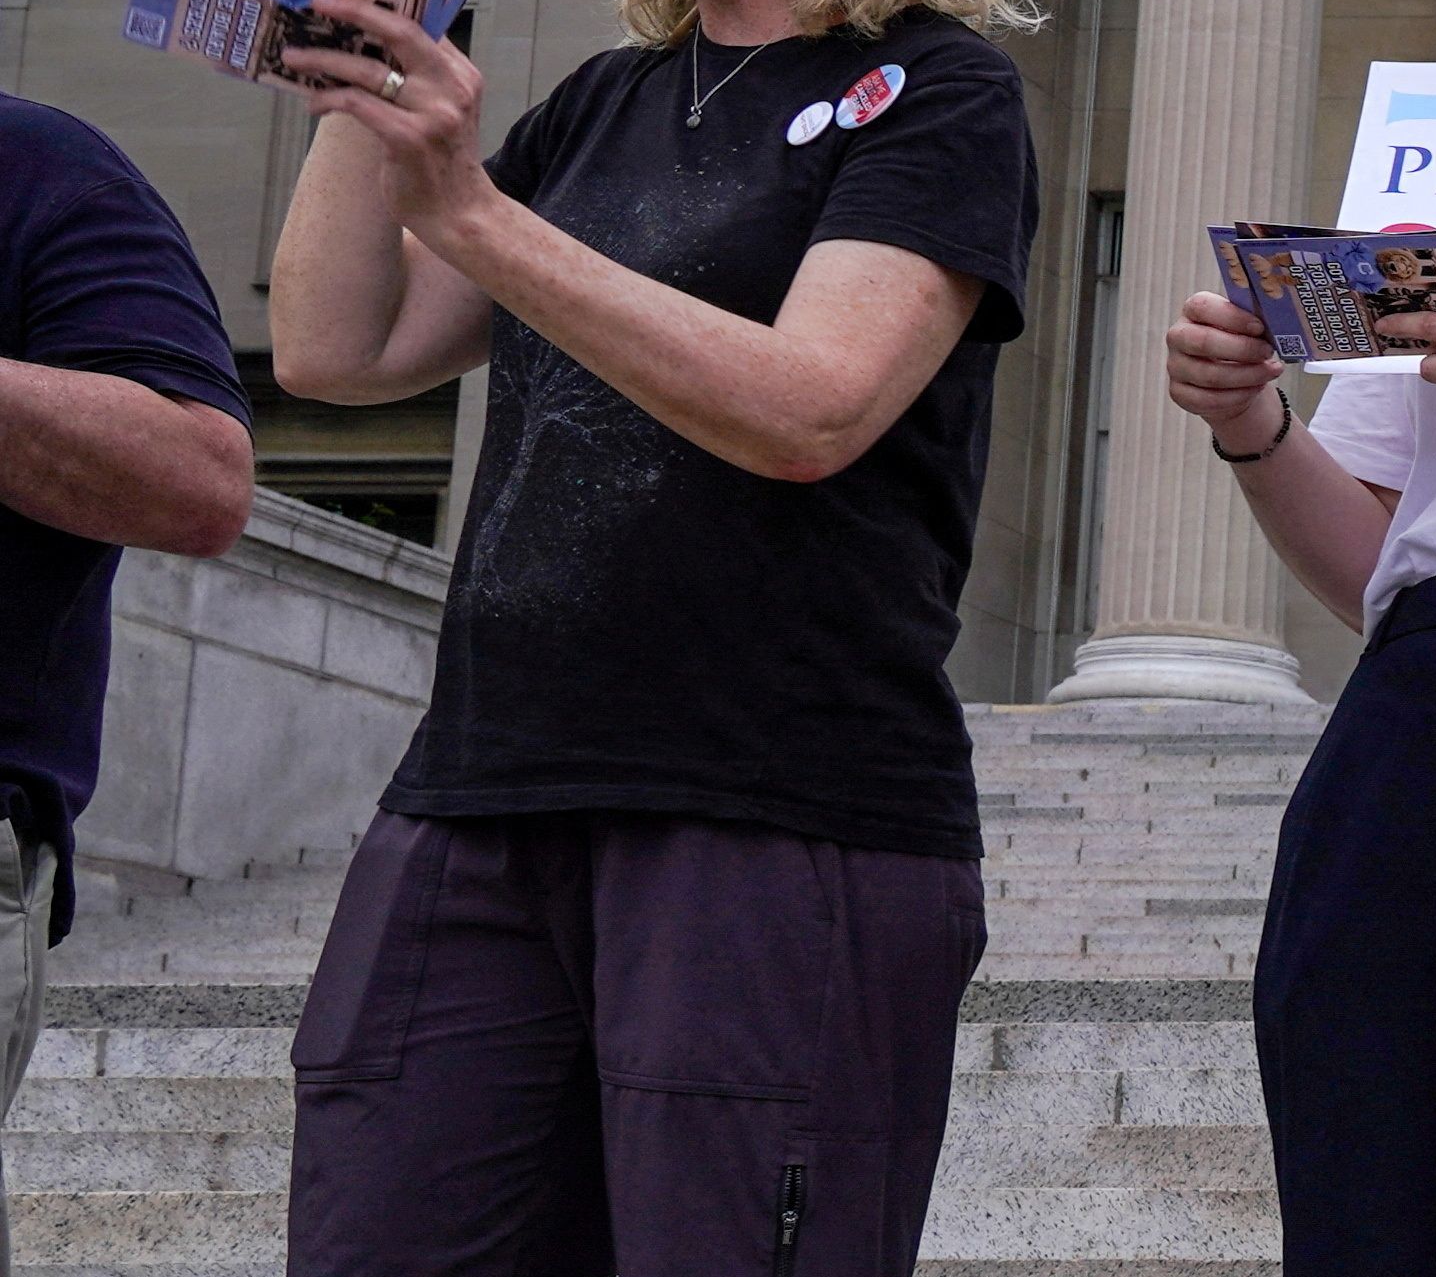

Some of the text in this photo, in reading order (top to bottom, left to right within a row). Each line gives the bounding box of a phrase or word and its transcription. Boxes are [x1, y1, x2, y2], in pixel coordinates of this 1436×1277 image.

[1289, 265, 1305, 283] OF
[1308, 263, 1353, 353] FOR THE BOARD
[1326, 261, 1373, 354] GOT A QUESTION
